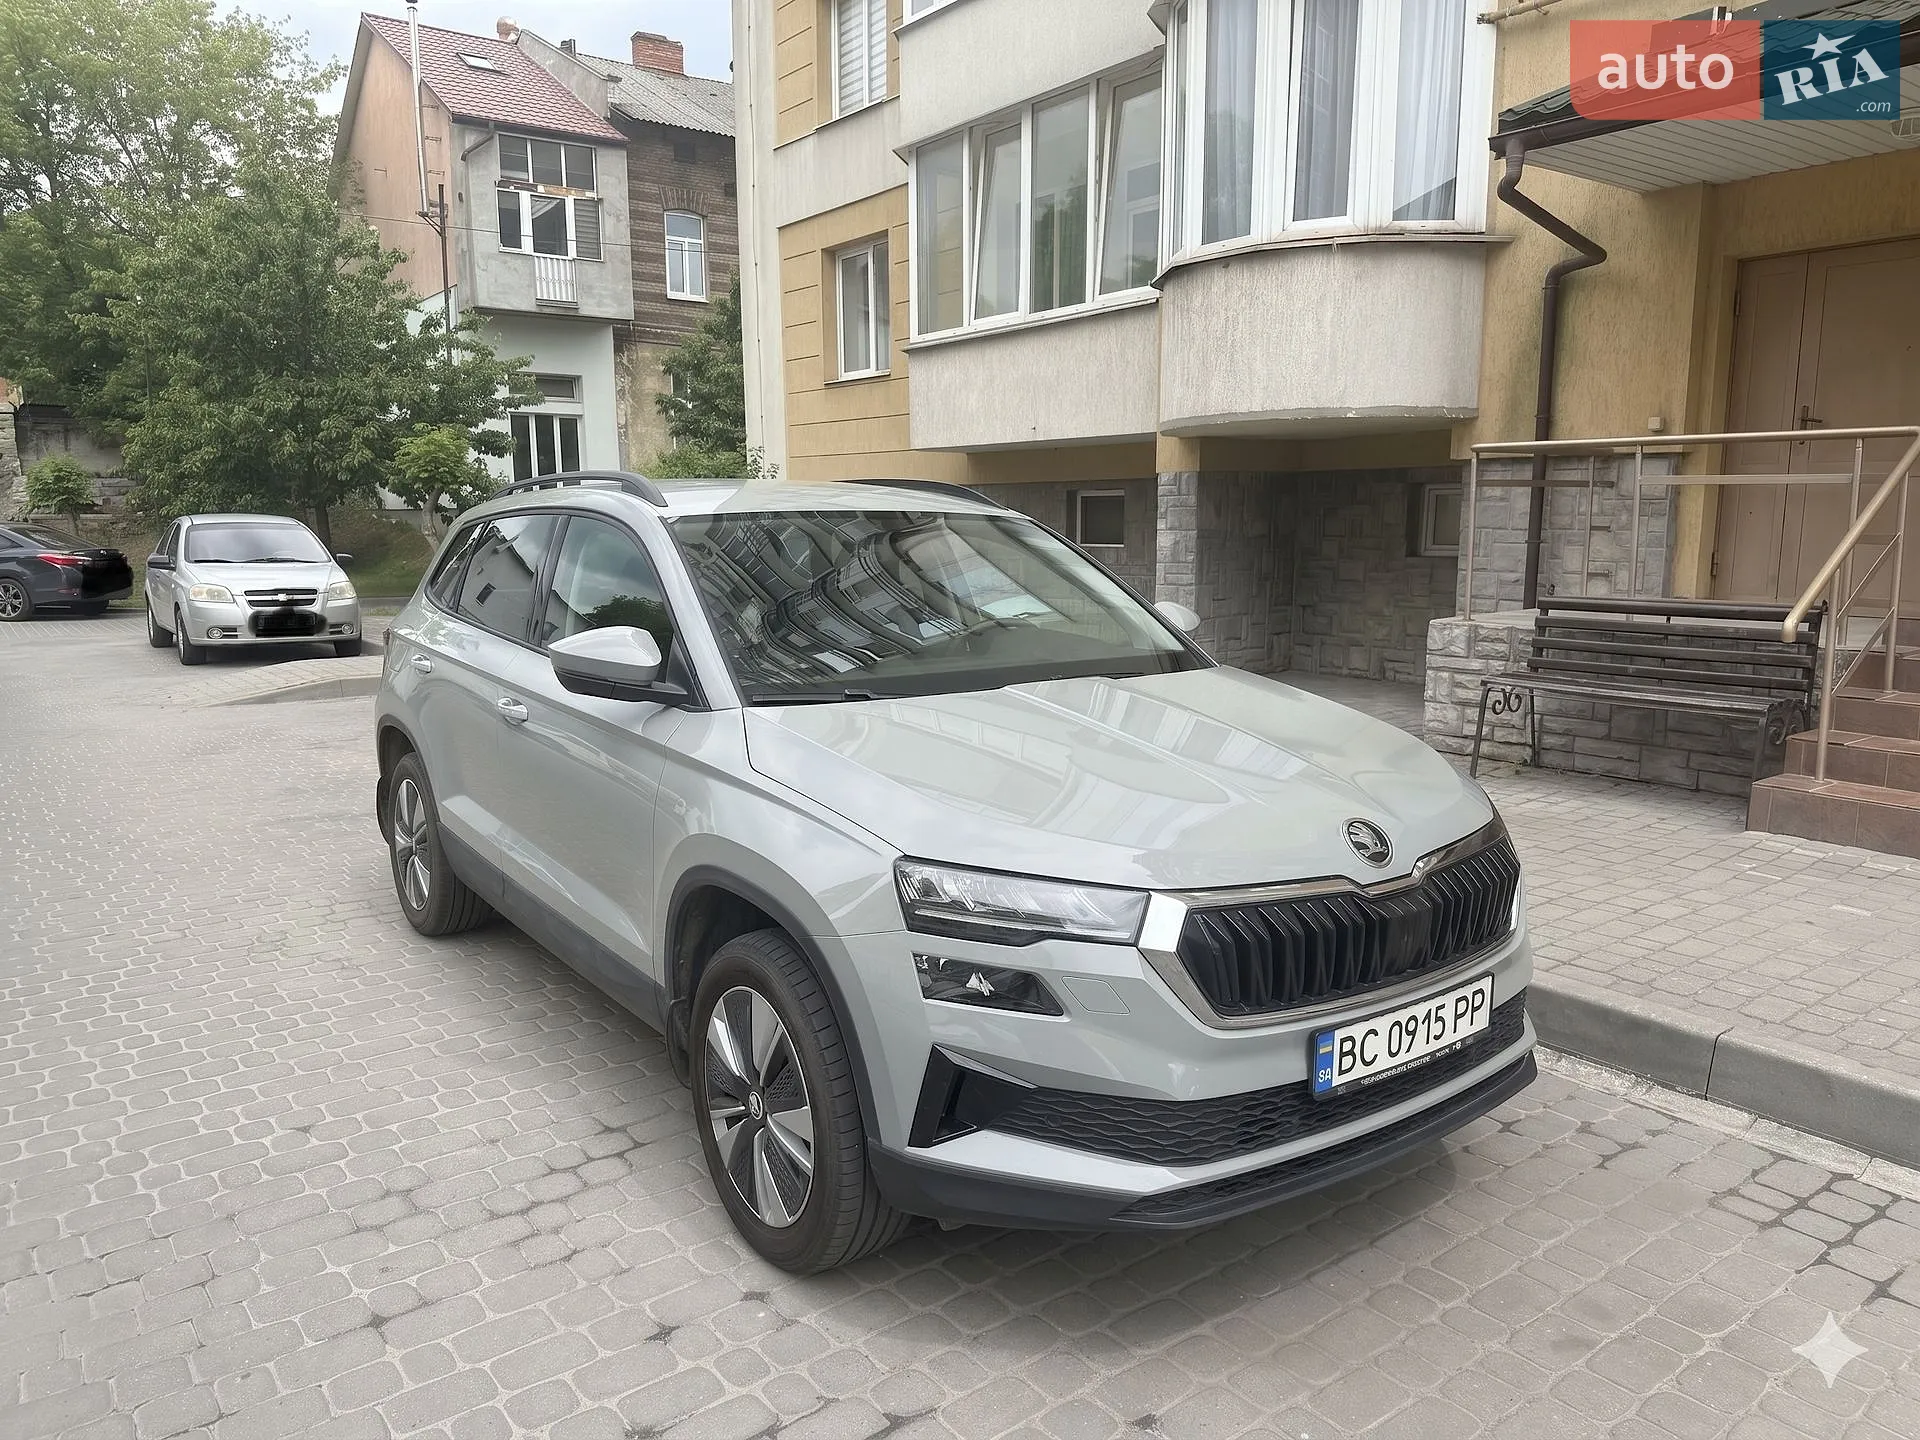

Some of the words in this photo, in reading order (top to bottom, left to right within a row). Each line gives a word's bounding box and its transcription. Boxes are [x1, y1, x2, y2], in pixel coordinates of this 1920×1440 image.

[1337, 1028, 1379, 1077] BC
[1387, 1003, 1446, 1058] 0915
[1452, 987, 1485, 1034] PP
